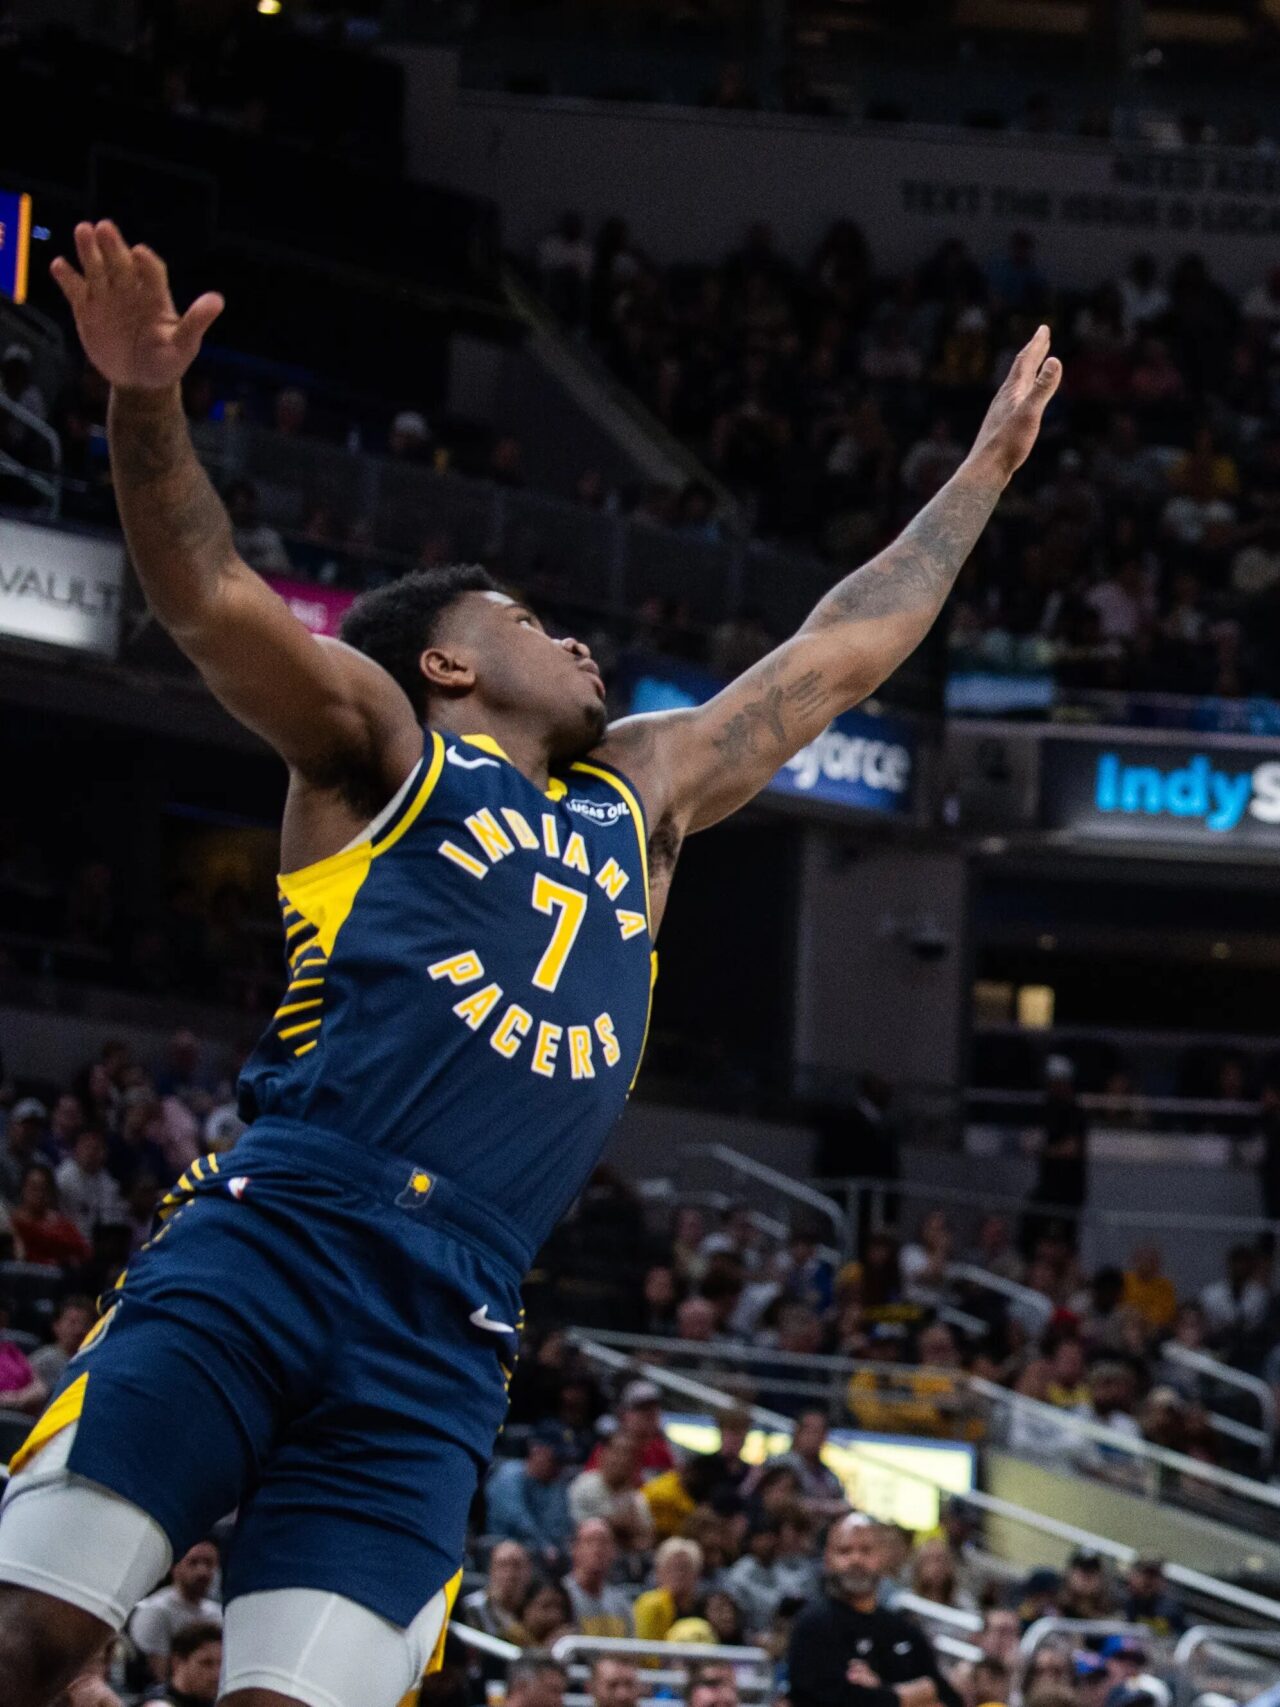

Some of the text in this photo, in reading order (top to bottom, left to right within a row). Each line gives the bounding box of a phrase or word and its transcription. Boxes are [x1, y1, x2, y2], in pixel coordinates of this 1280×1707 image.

[607, 801, 631, 819] OIL
[438, 806, 647, 940] INDIANA
[532, 872, 588, 992] 7
[427, 949, 620, 1079] PACERS
